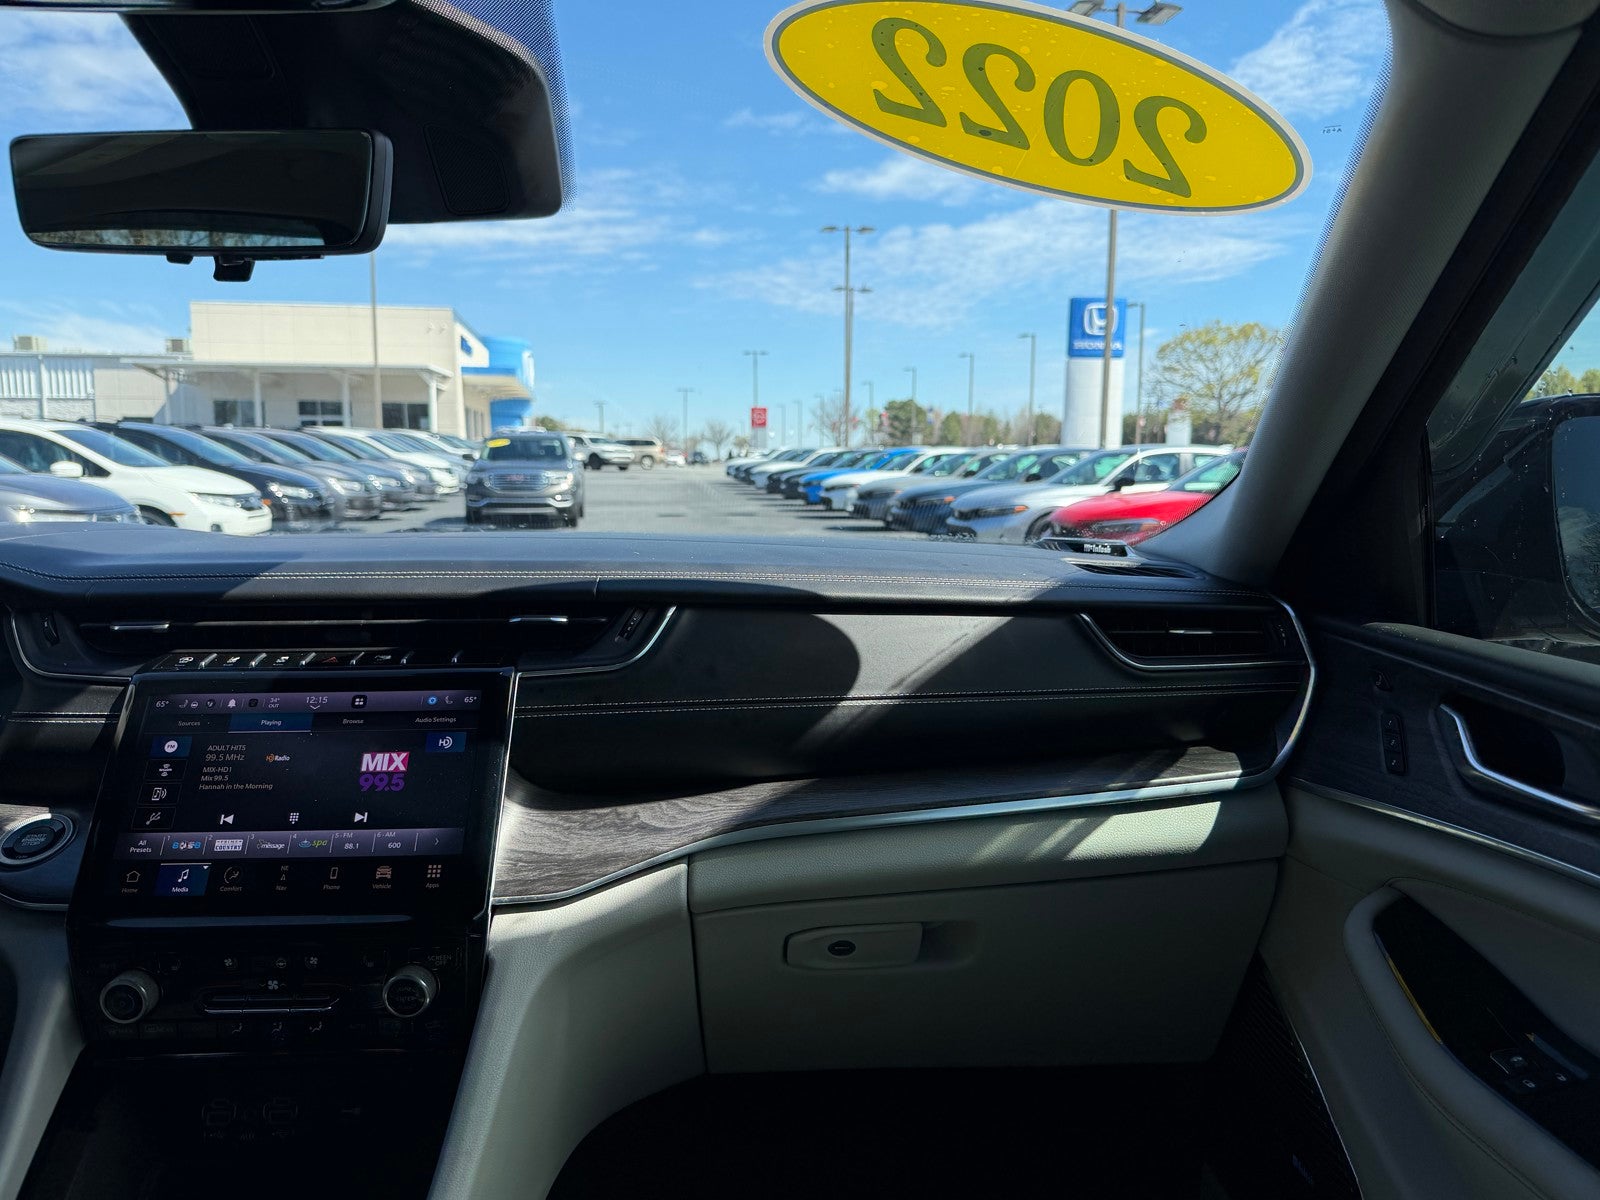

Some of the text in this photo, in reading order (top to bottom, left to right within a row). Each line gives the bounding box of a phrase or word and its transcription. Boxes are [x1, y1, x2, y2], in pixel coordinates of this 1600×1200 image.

[1072, 341, 1122, 351] HONA
[155, 700, 170, 708] 65°
[305, 696, 329, 704] 12:15
[261, 719, 282, 727] Playing
[433, 716, 457, 724] Settings
[205, 753, 245, 761] 99.5 MHz
[361, 753, 408, 772] MIX
[359, 772, 405, 792] 99.5
[245, 782, 273, 791] Morning
[312, 839, 328, 848] spa
[344, 842, 359, 850] 88.1
[129, 846, 152, 854] Presets
